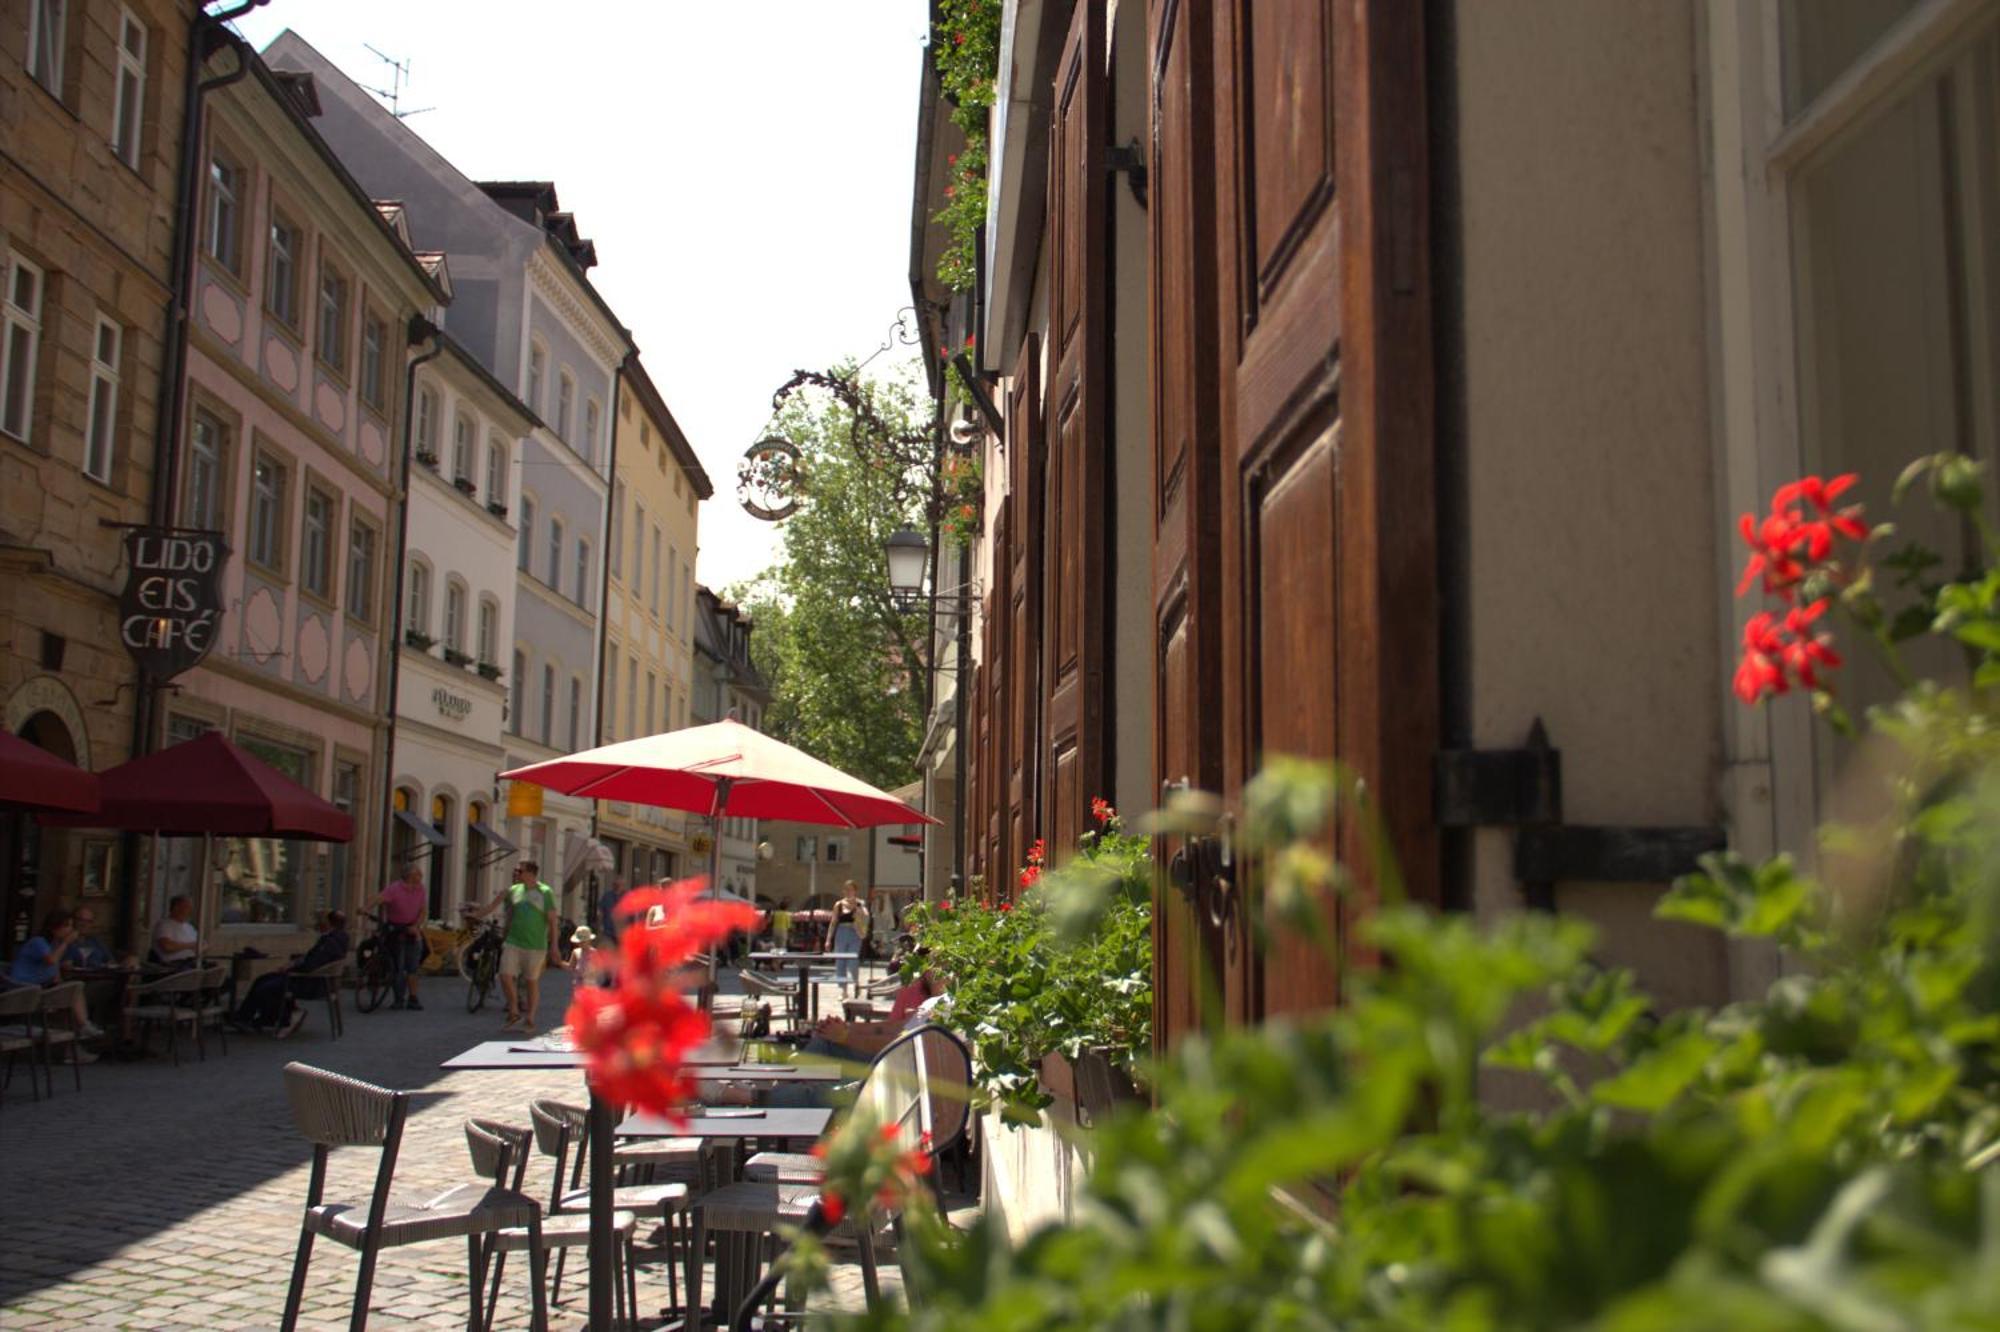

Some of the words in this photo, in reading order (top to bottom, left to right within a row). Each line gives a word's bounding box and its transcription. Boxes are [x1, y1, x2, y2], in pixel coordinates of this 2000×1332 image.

[136, 537, 213, 572] LIDO
[139, 577, 198, 611] EIS
[122, 609, 212, 651] CAFÉ
